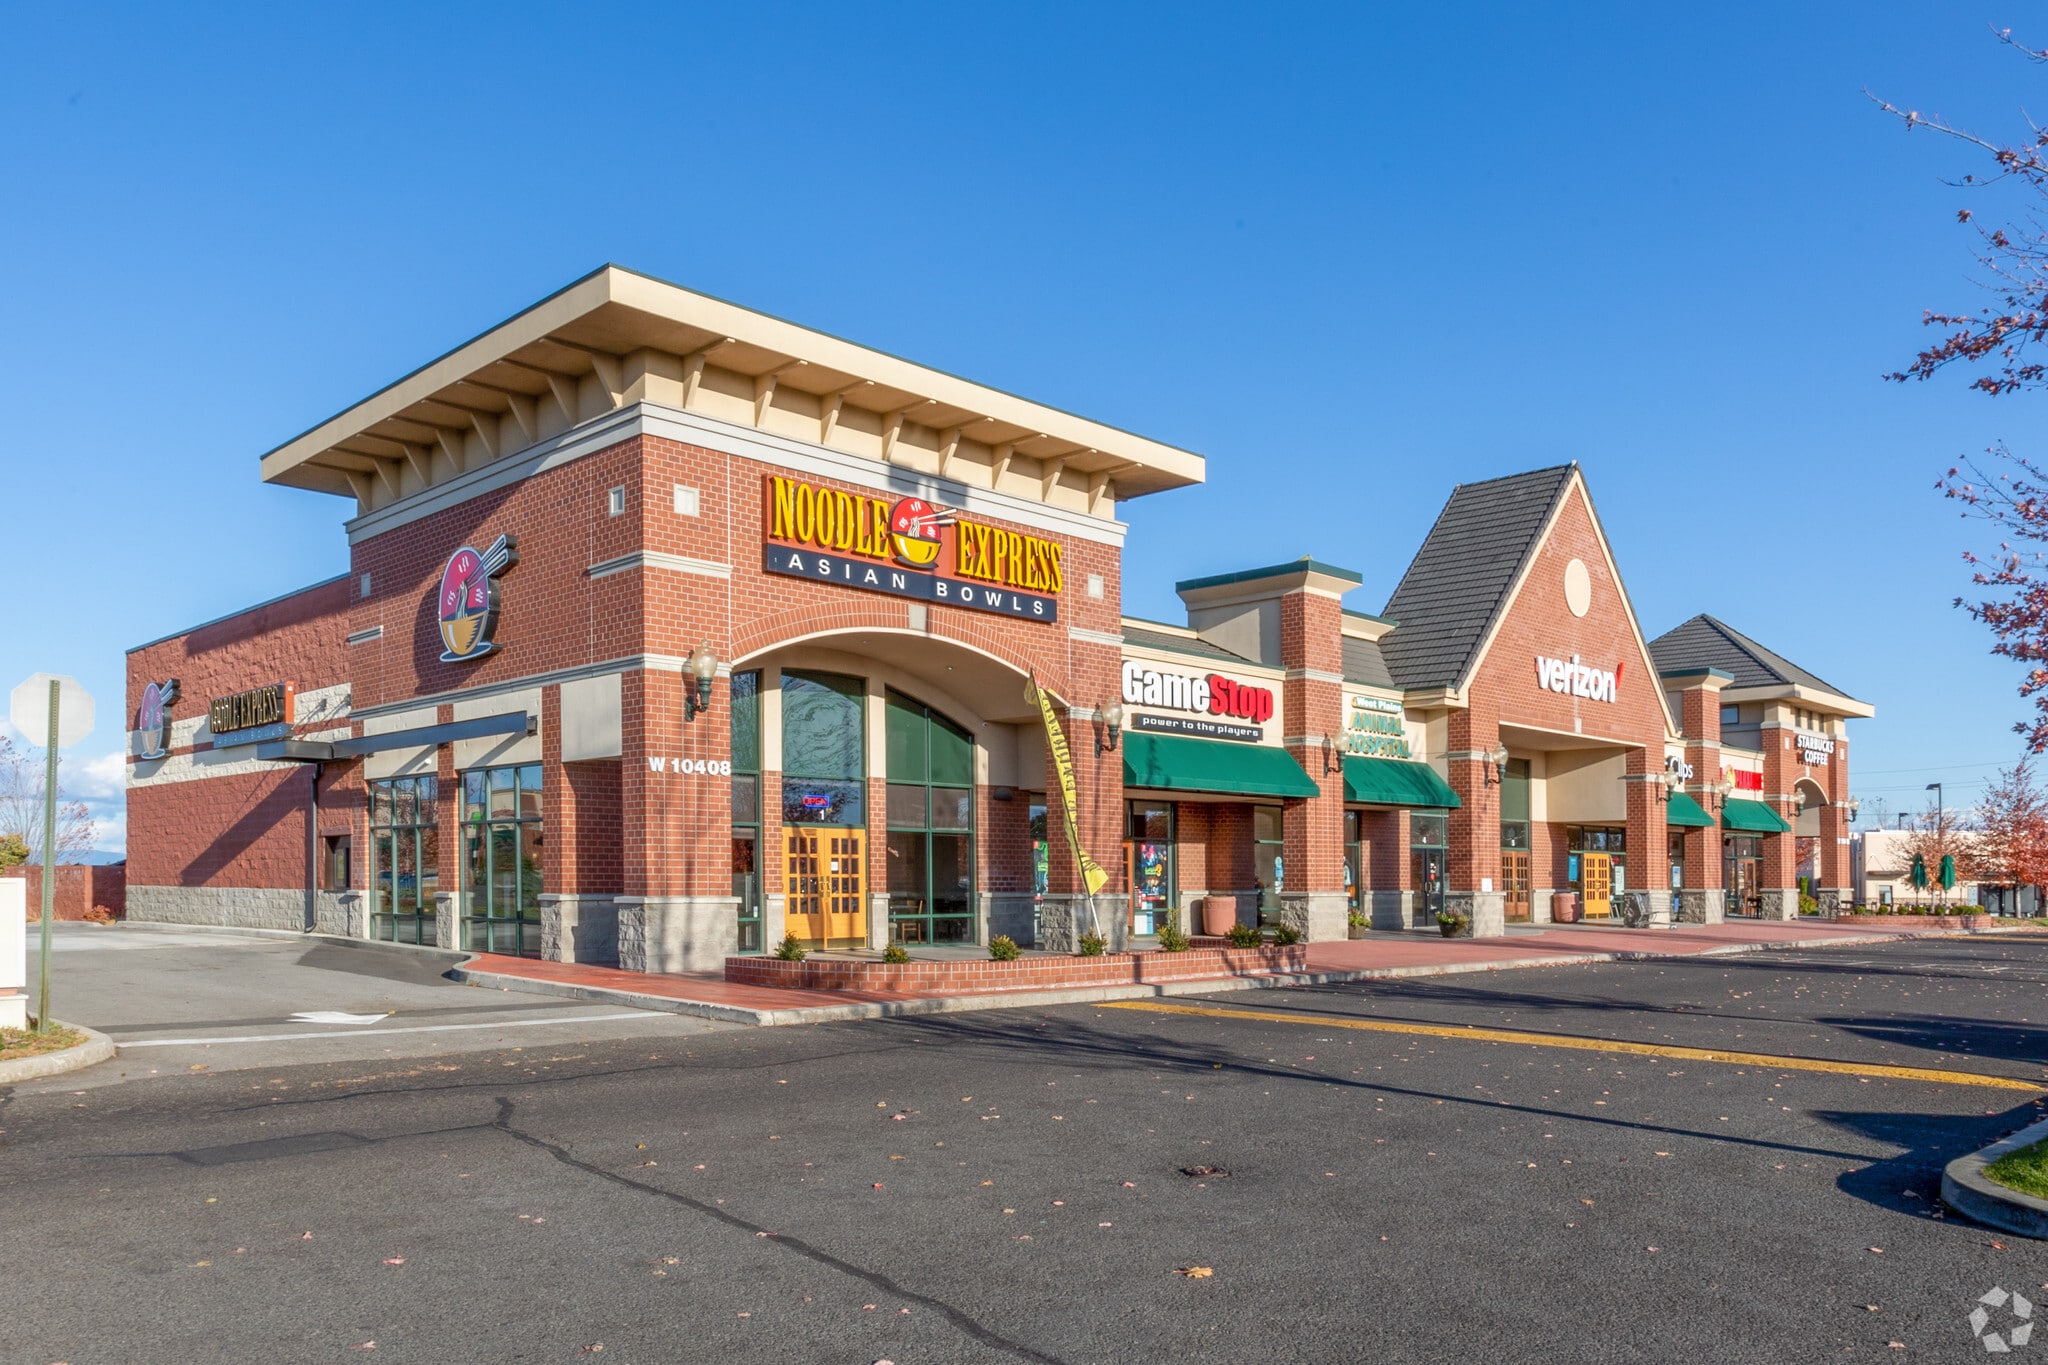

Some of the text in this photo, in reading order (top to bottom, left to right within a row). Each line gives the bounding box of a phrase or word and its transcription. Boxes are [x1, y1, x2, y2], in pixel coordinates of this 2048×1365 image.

[770, 476, 1062, 593] NOODLE EXPRESS
[788, 553, 1044, 615] ASIAN BOWLS
[1536, 653, 1616, 704] verizon
[1121, 660, 1273, 722] GameStop
[241, 685, 279, 728] EXPRESS
[1355, 695, 1403, 712] West Plains
[1142, 717, 1259, 737] power to the players
[1352, 711, 1405, 735] ANIMAL
[1797, 734, 1834, 754] STARBUCKS
[648, 756, 731, 776] W 10408
[1804, 749, 1828, 766] COFFEE
[1670, 756, 1693, 783] Clips
[802, 797, 827, 806] OPEN
[819, 809, 825, 820] 1
